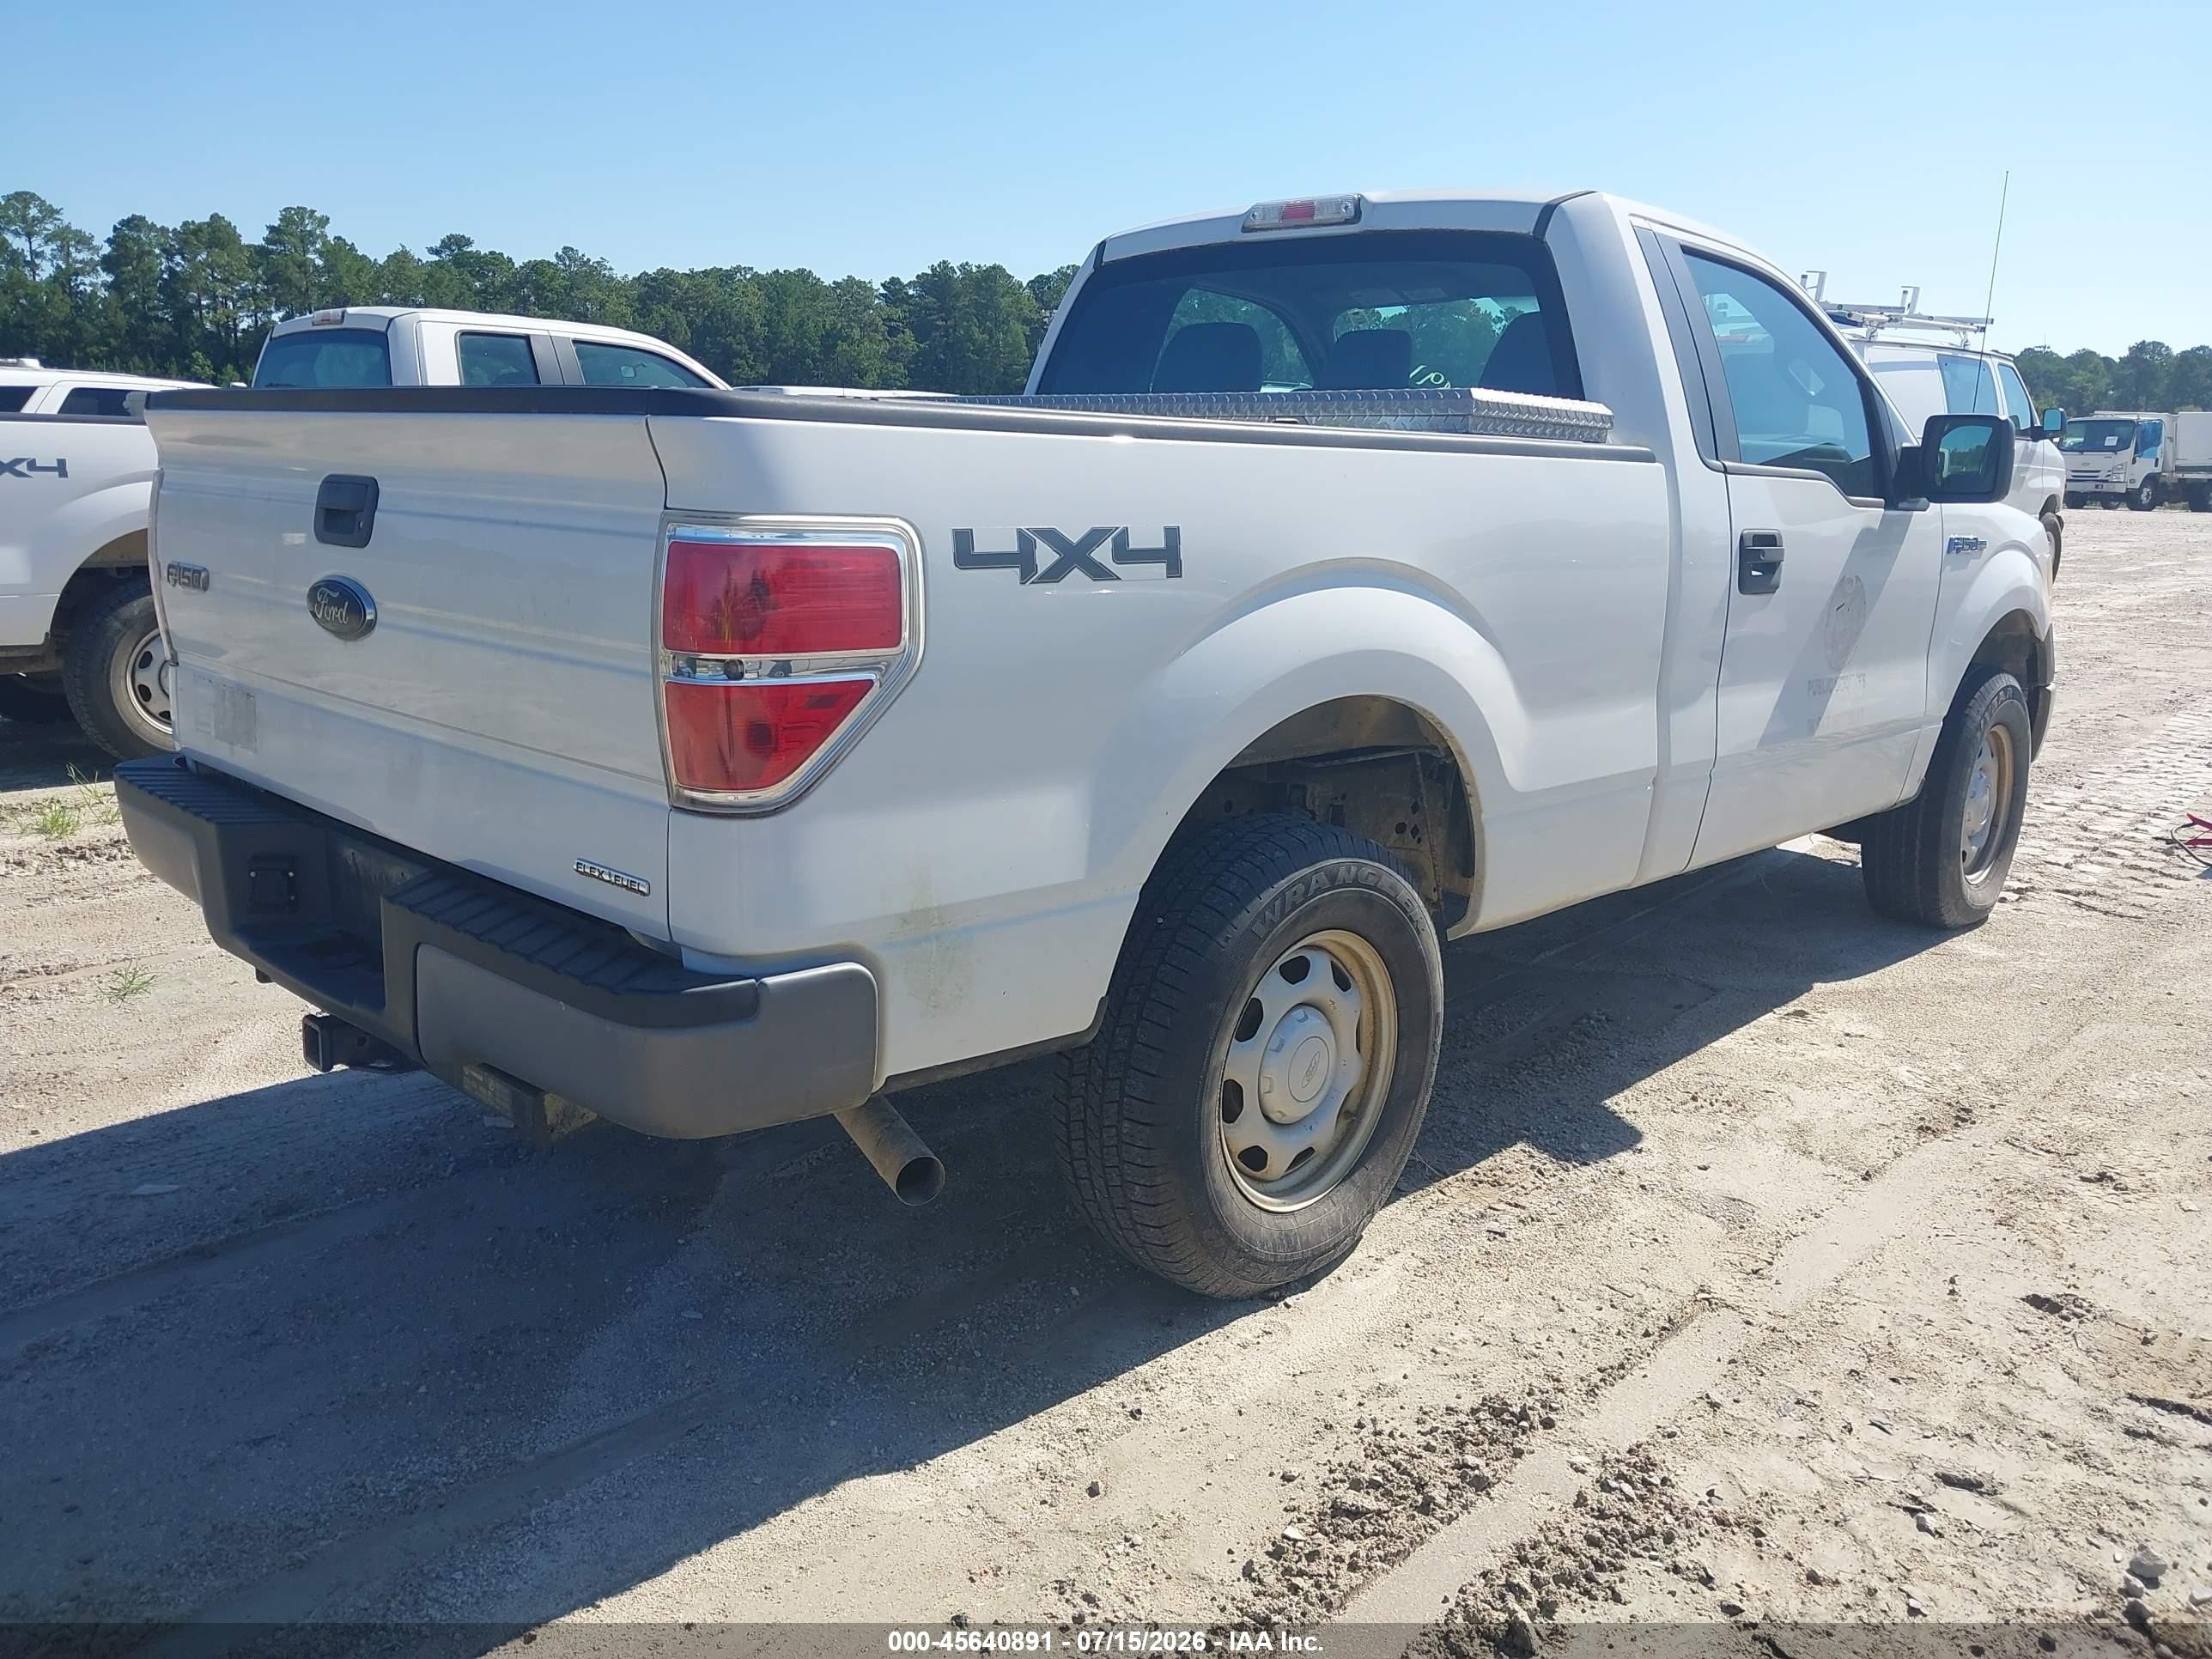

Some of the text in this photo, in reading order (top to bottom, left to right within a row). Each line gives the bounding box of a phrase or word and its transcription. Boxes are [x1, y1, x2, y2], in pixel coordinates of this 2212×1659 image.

[952, 526, 1182, 585] 4X4
[315, 586, 349, 624] Ford
[576, 861, 647, 896] FLEX FUEL
[1251, 865, 1426, 936] WRANGLER
